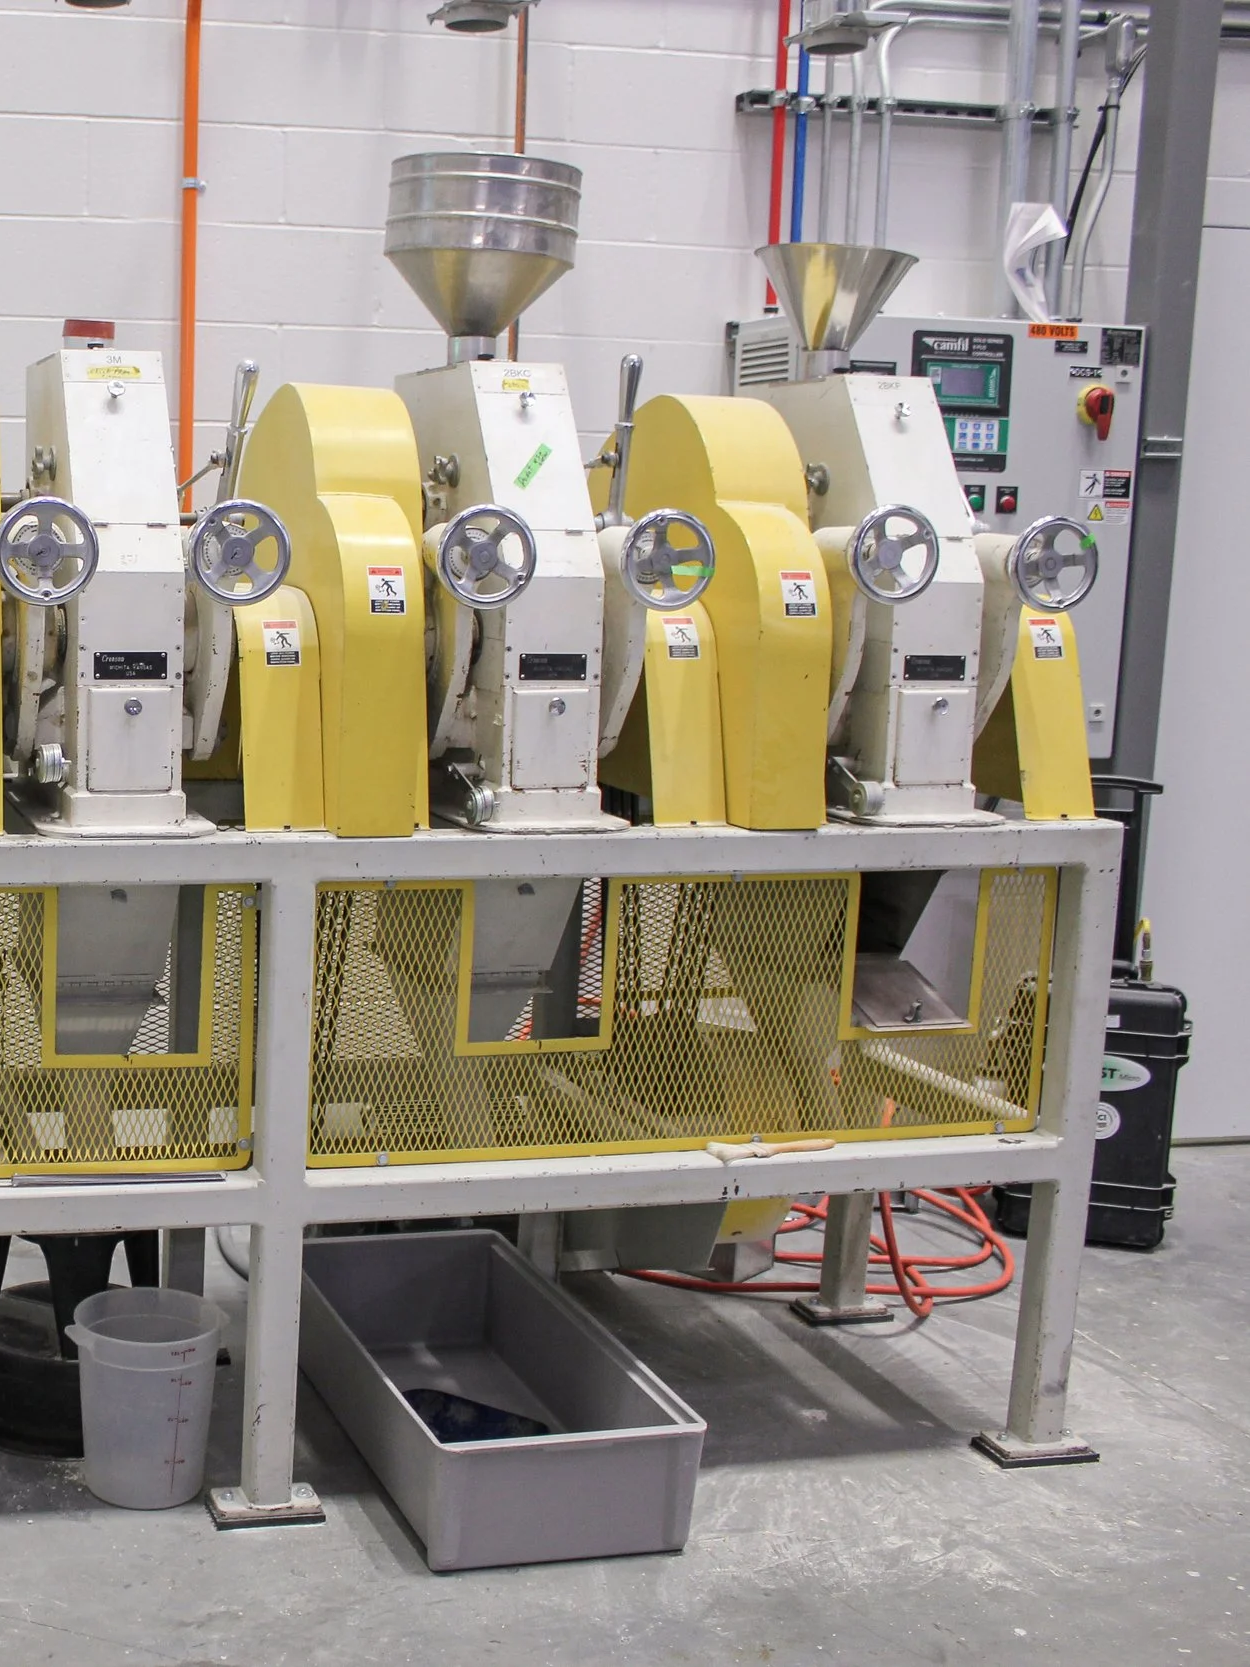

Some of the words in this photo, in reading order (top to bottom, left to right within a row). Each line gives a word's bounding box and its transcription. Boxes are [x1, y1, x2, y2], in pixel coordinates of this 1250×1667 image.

[1030, 325, 1046, 336] 480
[1049, 326, 1076, 338] VOLTS
[933, 337, 970, 352] camfil
[105, 355, 122, 365] 3M
[503, 368, 532, 378] 2BKC
